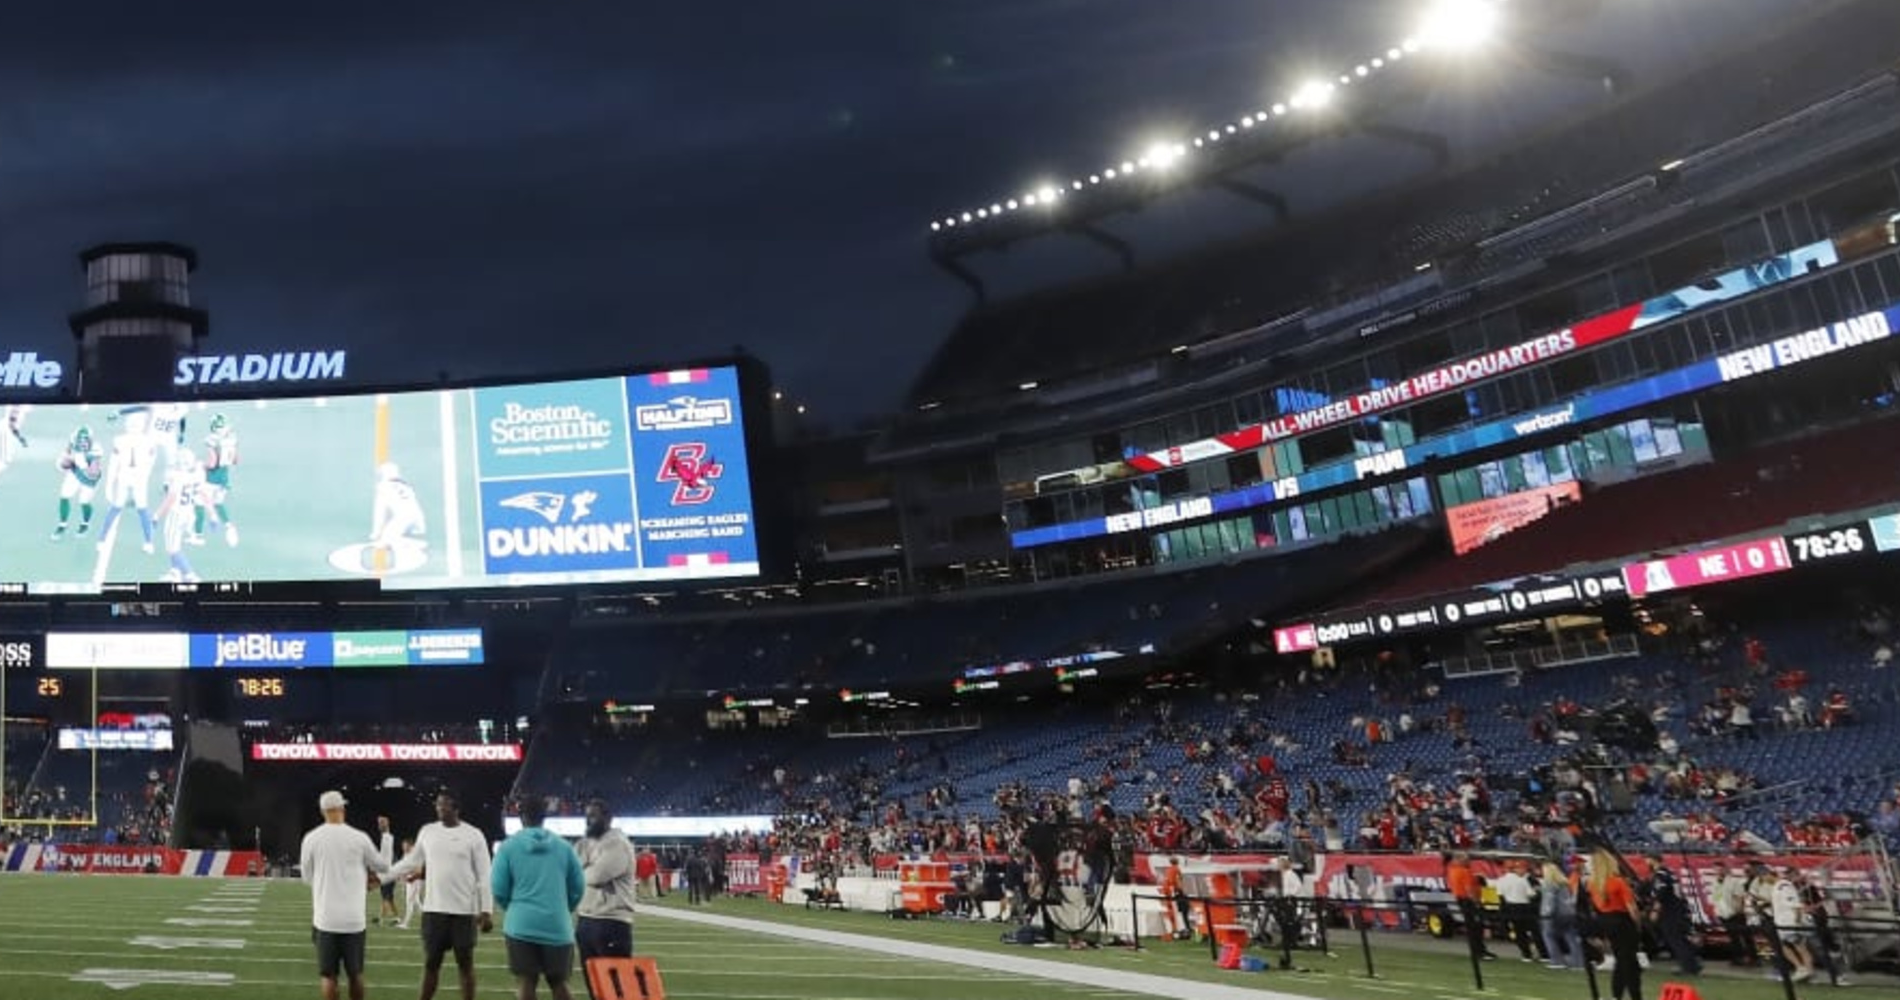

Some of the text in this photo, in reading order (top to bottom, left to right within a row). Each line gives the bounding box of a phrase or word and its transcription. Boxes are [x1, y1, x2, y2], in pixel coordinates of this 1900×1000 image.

[1716, 311, 1891, 382] NEW ENGLAND
[173, 351, 345, 385] STADIUM
[1260, 328, 1576, 442] ALL-WHEEL DRIVE HEADQUARTERS
[491, 410, 612, 444] Scientific
[505, 403, 580, 425] Boston
[641, 406, 726, 425] HALFTIME
[1272, 477, 1299, 500] VS
[1105, 497, 1212, 534] NEW ENGLAND
[487, 522, 632, 557] DUNKIN'
[1794, 529, 1863, 561] 78:26
[1698, 554, 1728, 578] NE
[1747, 547, 1764, 569] 0
[214, 633, 305, 666] jetBlue
[38, 678, 59, 696] 25
[238, 678, 283, 696] 78:26
[260, 743, 519, 760] TOYOTA TOYOTA TOYOTA TOYOTA
[93, 852, 163, 868] ENGLAND
